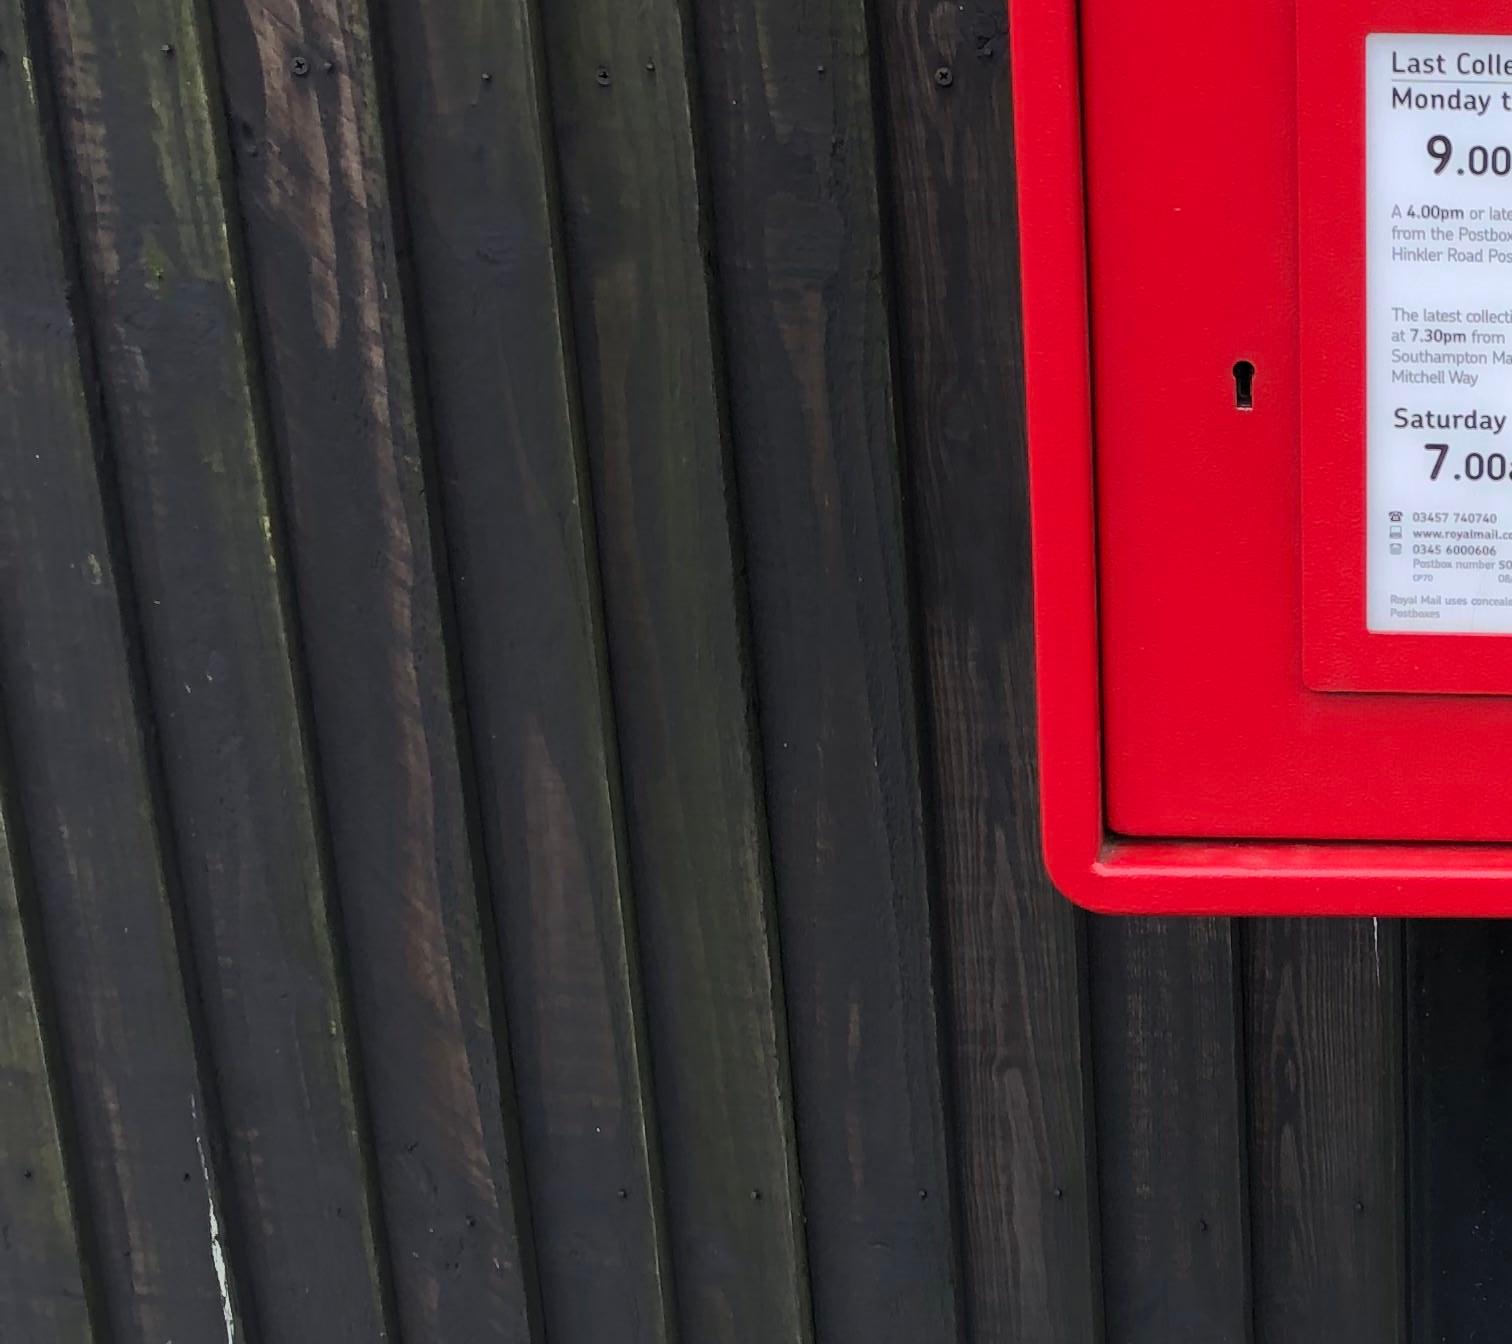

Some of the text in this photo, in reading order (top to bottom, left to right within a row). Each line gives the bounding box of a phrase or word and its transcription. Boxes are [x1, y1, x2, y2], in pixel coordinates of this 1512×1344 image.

[1391, 51, 1446, 75] Last
[1391, 88, 1491, 116] Monday
[1391, 205, 1402, 219] A
[1407, 205, 1464, 223] 4.00pm
[1469, 210, 1485, 221] or
[1391, 226, 1426, 241] from
[1431, 227, 1454, 241] the
[1392, 247, 1443, 262] Hinkler
[1448, 248, 1483, 263] Road
[1391, 307, 1419, 322] The
[1423, 308, 1462, 323] latest
[1391, 329, 1505, 345] at 7.30pm from
[1391, 349, 1487, 366] Southampton
[1392, 370, 1478, 387] Mitchell Way
[1394, 408, 1506, 434] Saturday
[1412, 512, 1497, 524] 03457 740740
[1412, 544, 1496, 556] 0345 6000606
[1413, 559, 1452, 570] Postbox
[1456, 560, 1496, 570] number
[1390, 595, 1418, 606] Royal
[1420, 595, 1441, 605] Mail
[1445, 598, 1467, 606] uses
[1390, 608, 1440, 619] Postboxes
